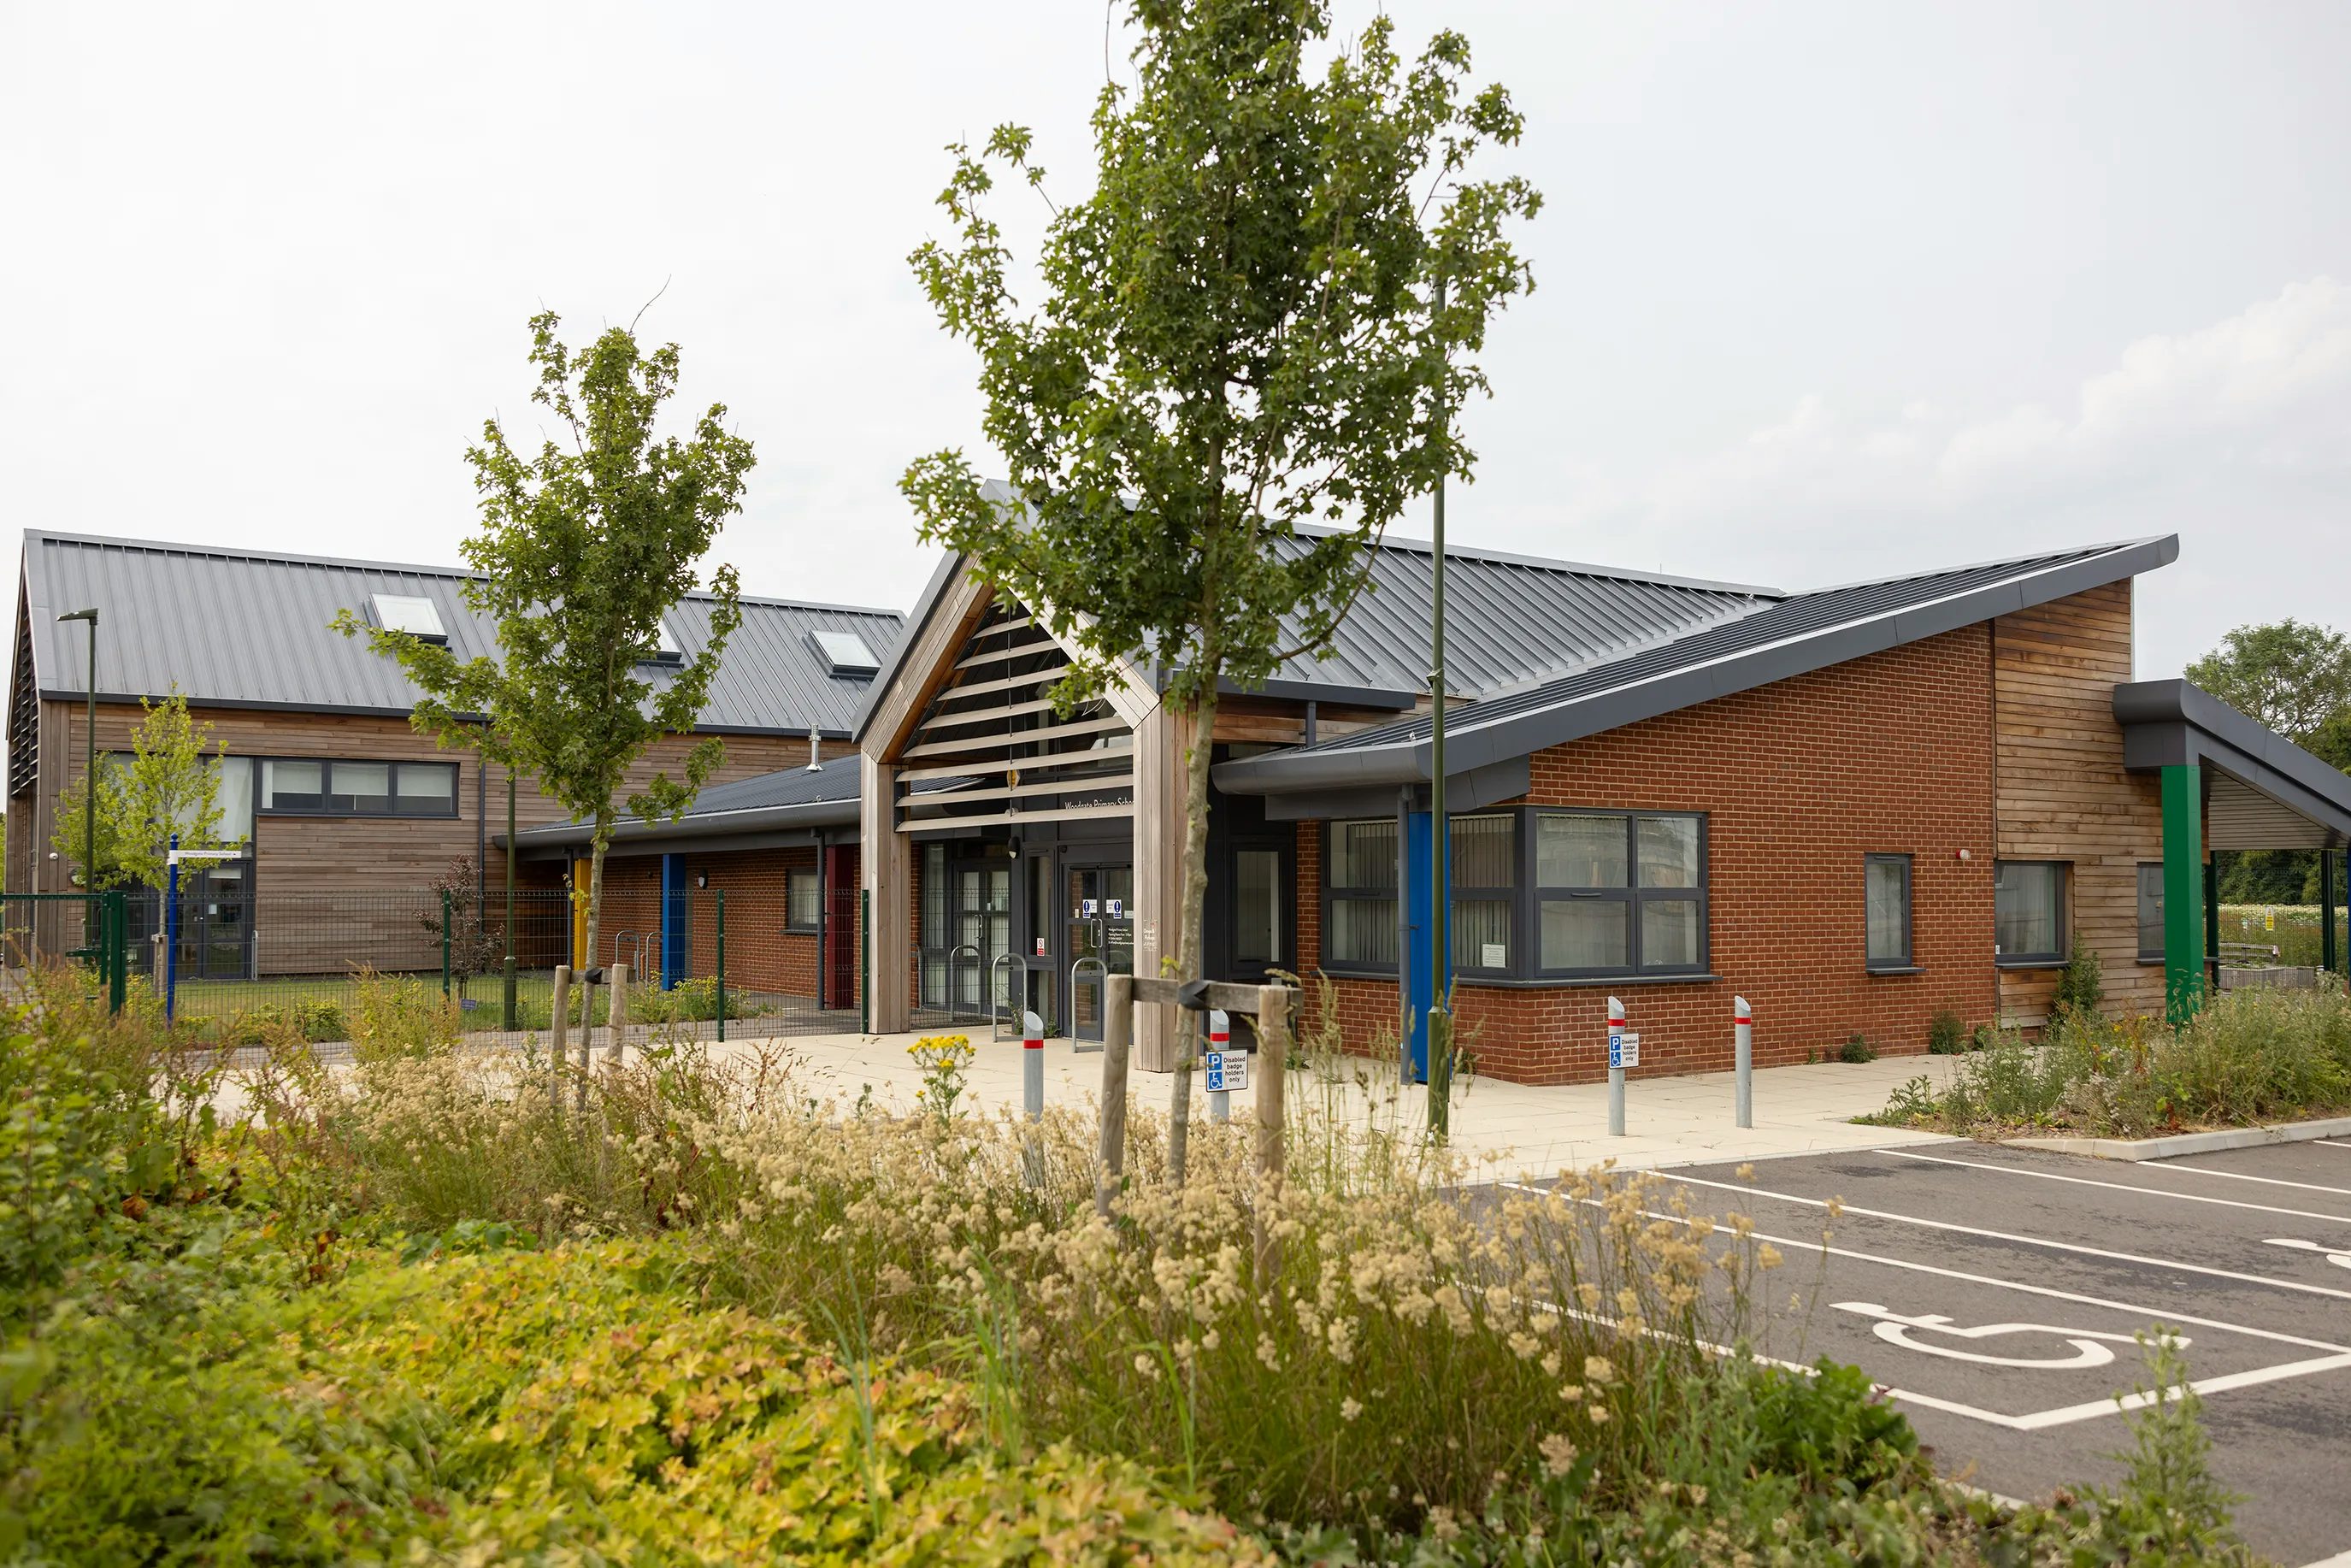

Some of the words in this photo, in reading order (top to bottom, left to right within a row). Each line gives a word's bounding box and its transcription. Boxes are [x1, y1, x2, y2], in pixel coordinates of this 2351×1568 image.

[1117, 797, 1134, 805] Schoo
[1613, 1037, 1619, 1049] P
[1211, 1055, 1220, 1069] P
